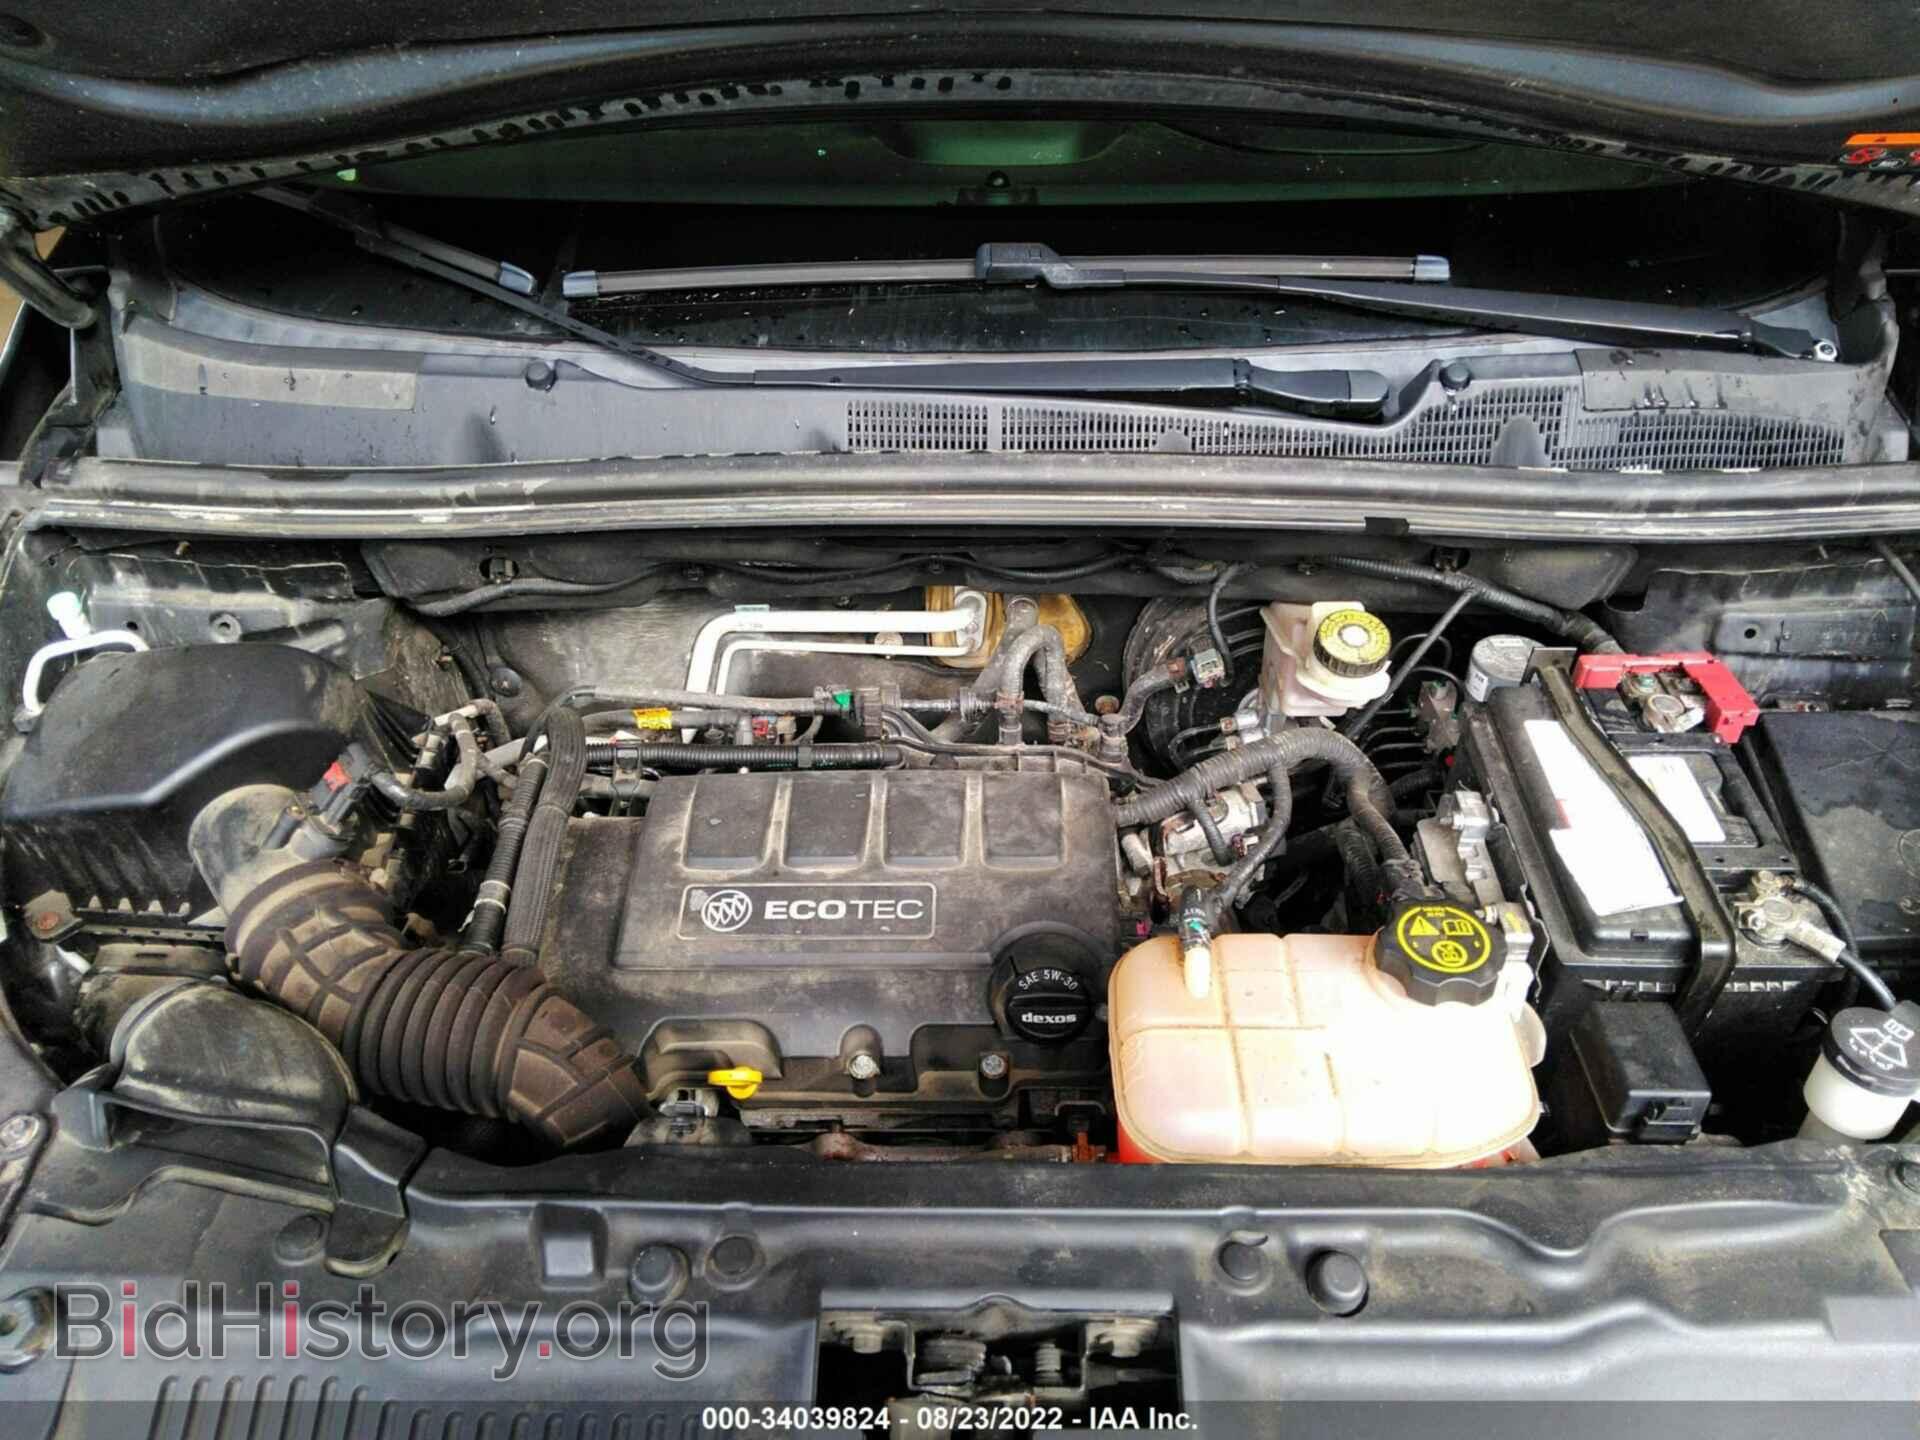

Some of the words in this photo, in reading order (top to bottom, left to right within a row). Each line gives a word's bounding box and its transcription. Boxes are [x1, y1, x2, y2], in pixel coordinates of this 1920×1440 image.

[764, 900, 924, 920] ECOTEC
[1018, 971, 1040, 991] SAE
[1043, 969, 1079, 991] 5W-30
[1021, 1012, 1077, 1024] dexos
